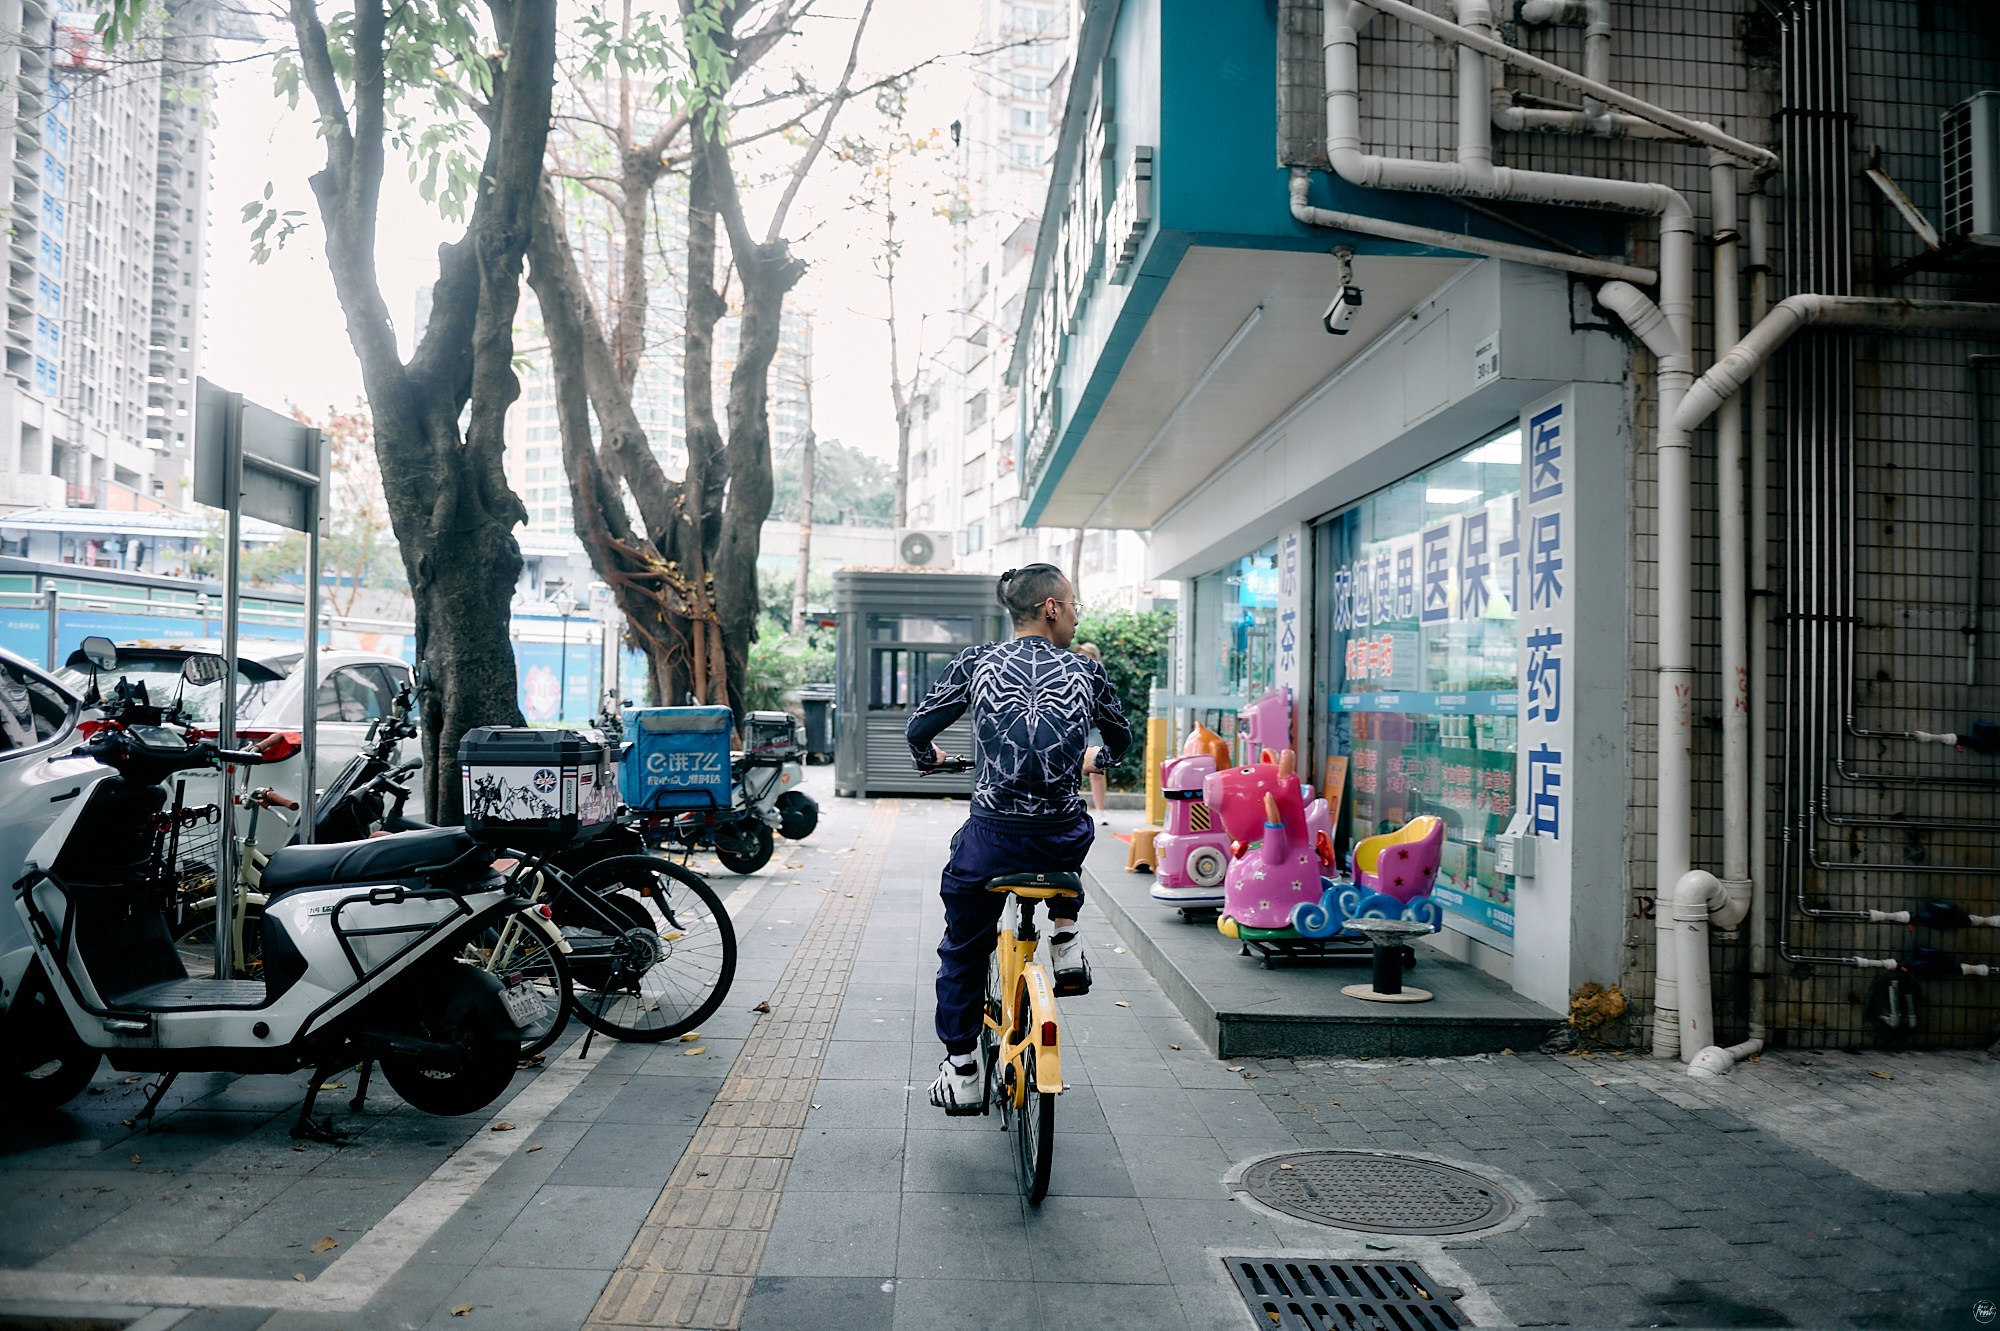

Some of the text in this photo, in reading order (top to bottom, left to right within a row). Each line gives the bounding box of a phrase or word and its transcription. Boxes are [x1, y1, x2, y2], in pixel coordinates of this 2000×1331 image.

[1528, 403, 1563, 840] 医保药店
[669, 752, 721, 772] 饿了么
[688, 774, 721, 785] 准时达
